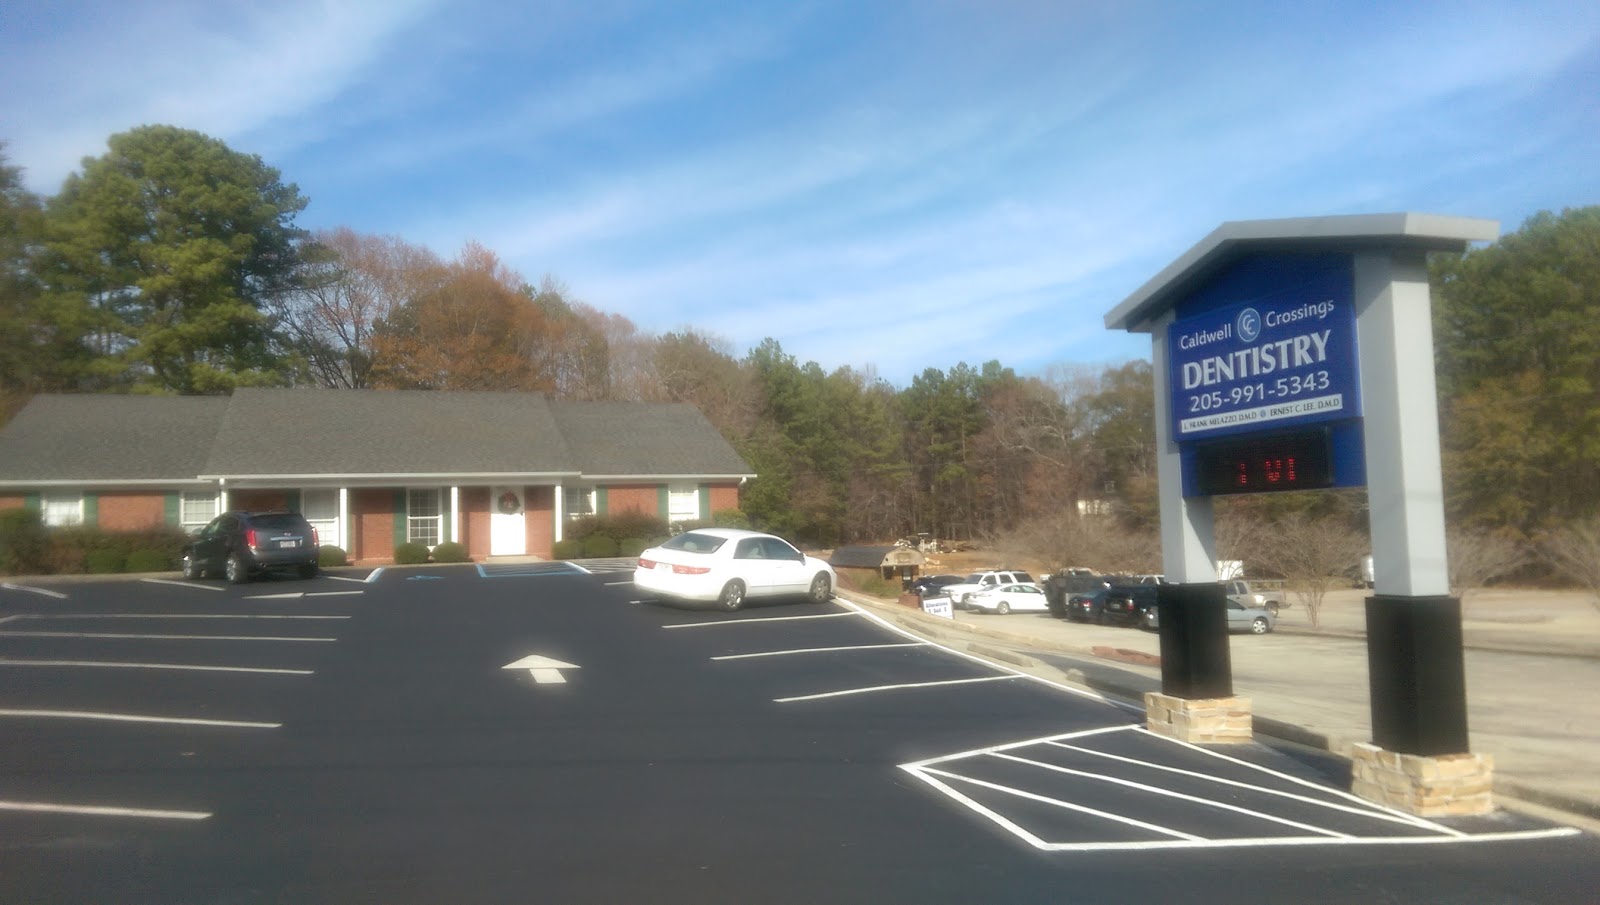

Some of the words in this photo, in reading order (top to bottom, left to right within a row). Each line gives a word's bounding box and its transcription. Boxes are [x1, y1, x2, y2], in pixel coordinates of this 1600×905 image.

[1181, 324, 1232, 350] Caldwell
[1266, 300, 1335, 327] Crossings
[1183, 329, 1331, 390] DENTISTRY
[1190, 370, 1330, 412] 205-991-5343
[1270, 406, 1293, 416] ERNEST
